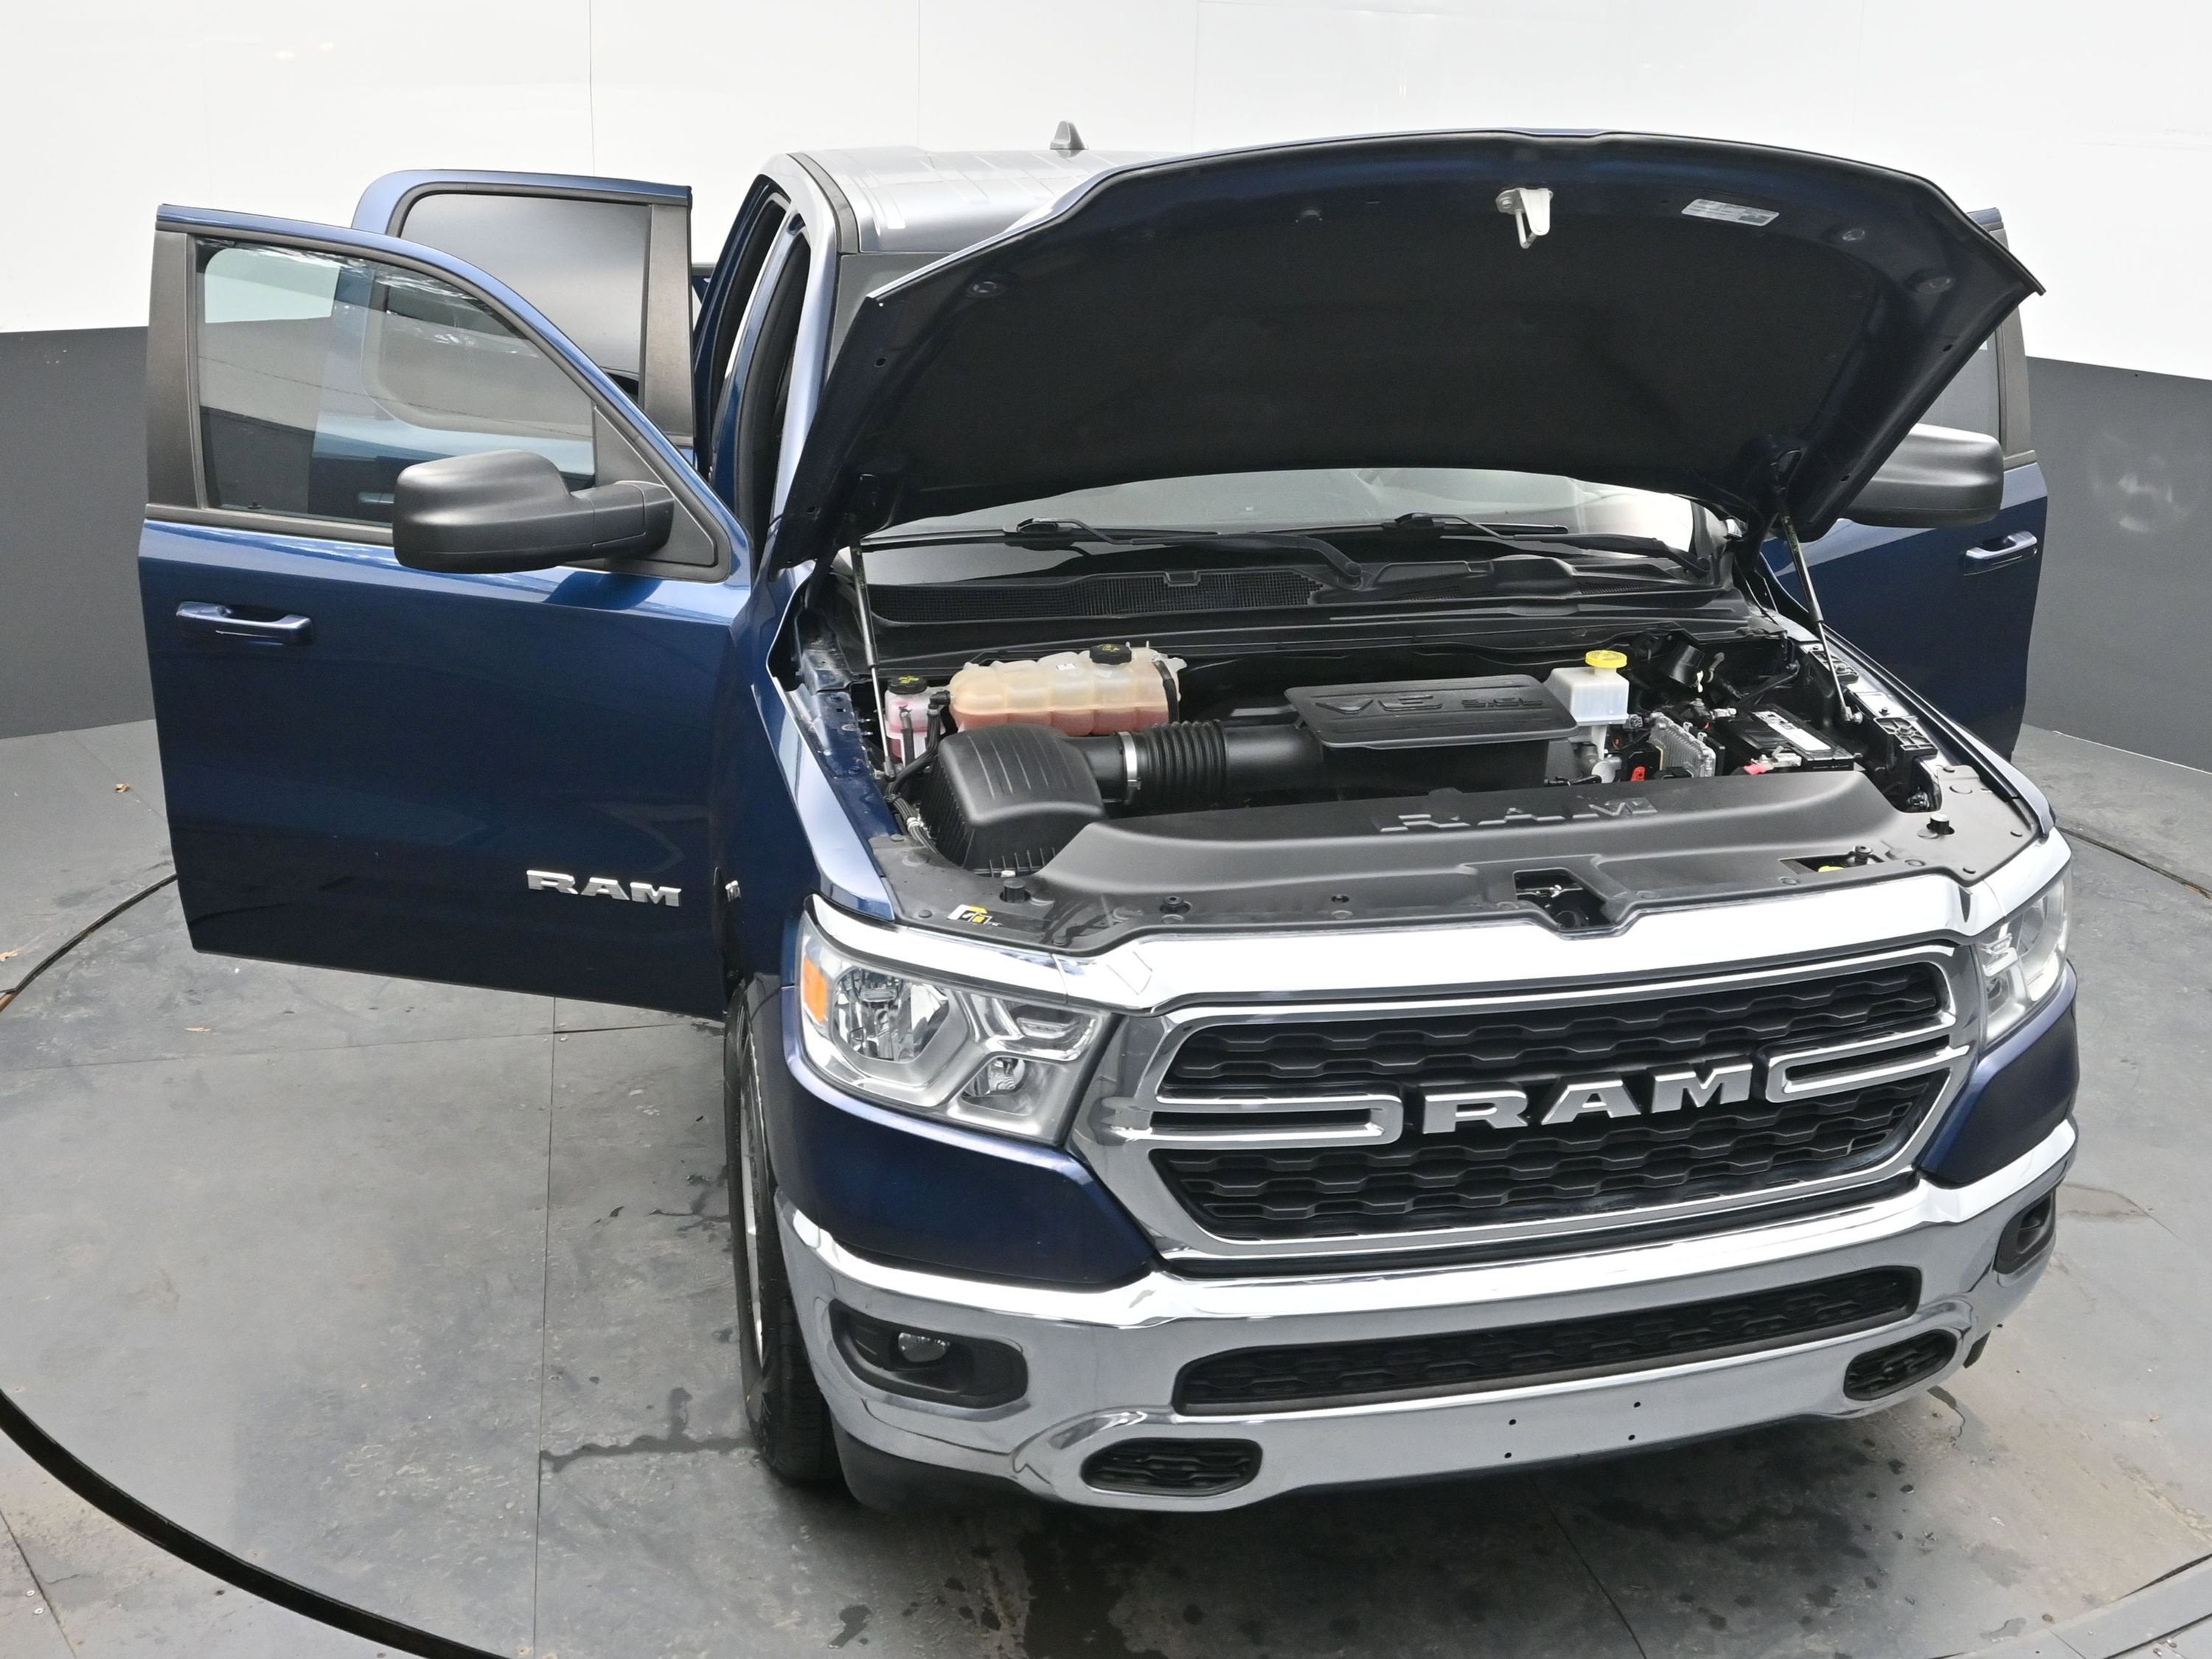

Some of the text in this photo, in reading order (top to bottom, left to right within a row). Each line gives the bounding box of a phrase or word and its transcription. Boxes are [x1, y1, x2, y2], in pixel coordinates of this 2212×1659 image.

[1376, 796, 1658, 832] RAM
[526, 869, 682, 908] RAM
[1420, 1057, 1754, 1135] RAM
